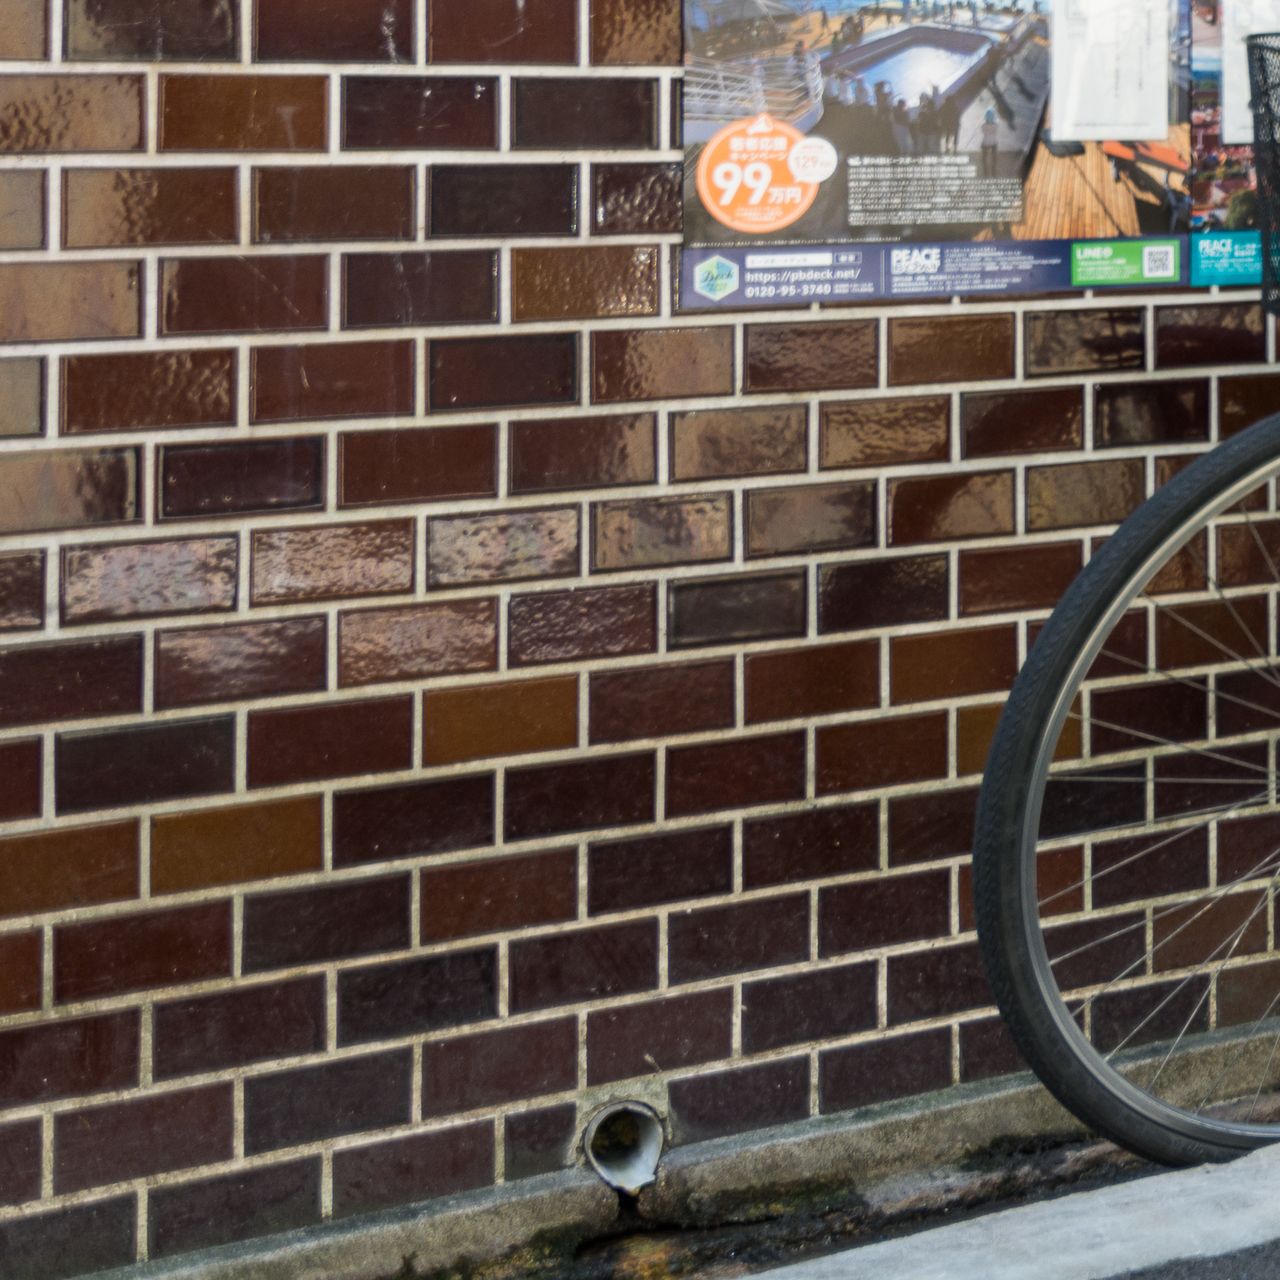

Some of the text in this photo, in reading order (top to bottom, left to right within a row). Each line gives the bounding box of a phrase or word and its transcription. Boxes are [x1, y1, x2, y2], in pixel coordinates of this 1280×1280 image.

[890, 248, 941, 264] PEACE
[745, 268, 861, 284] https://pbdeck.net/
[745, 284, 832, 299] 0120-95-3740
